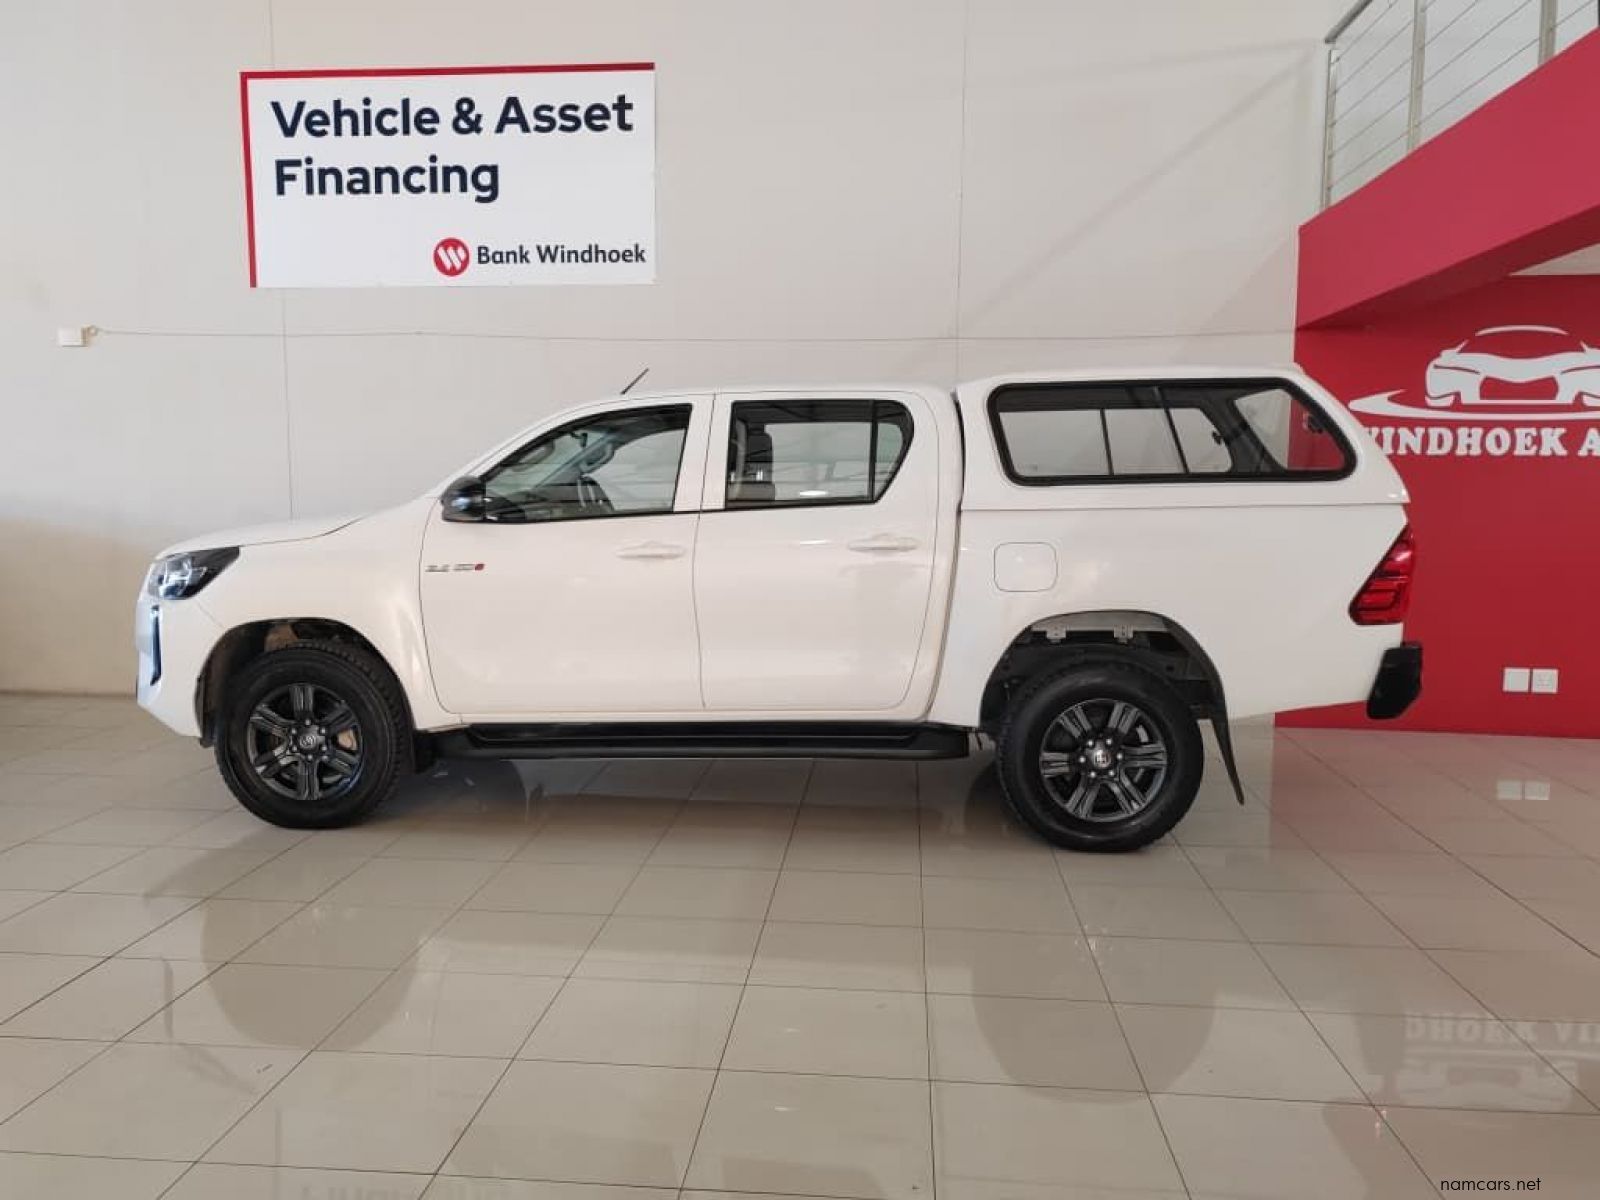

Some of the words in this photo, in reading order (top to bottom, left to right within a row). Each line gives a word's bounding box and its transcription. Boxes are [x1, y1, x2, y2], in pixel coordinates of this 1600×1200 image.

[271, 97, 440, 138] Vehicle
[452, 97, 483, 135] &
[495, 94, 634, 134] Asset
[275, 154, 499, 204] Financing
[477, 244, 531, 265] Bank
[536, 243, 646, 265] Windhoek
